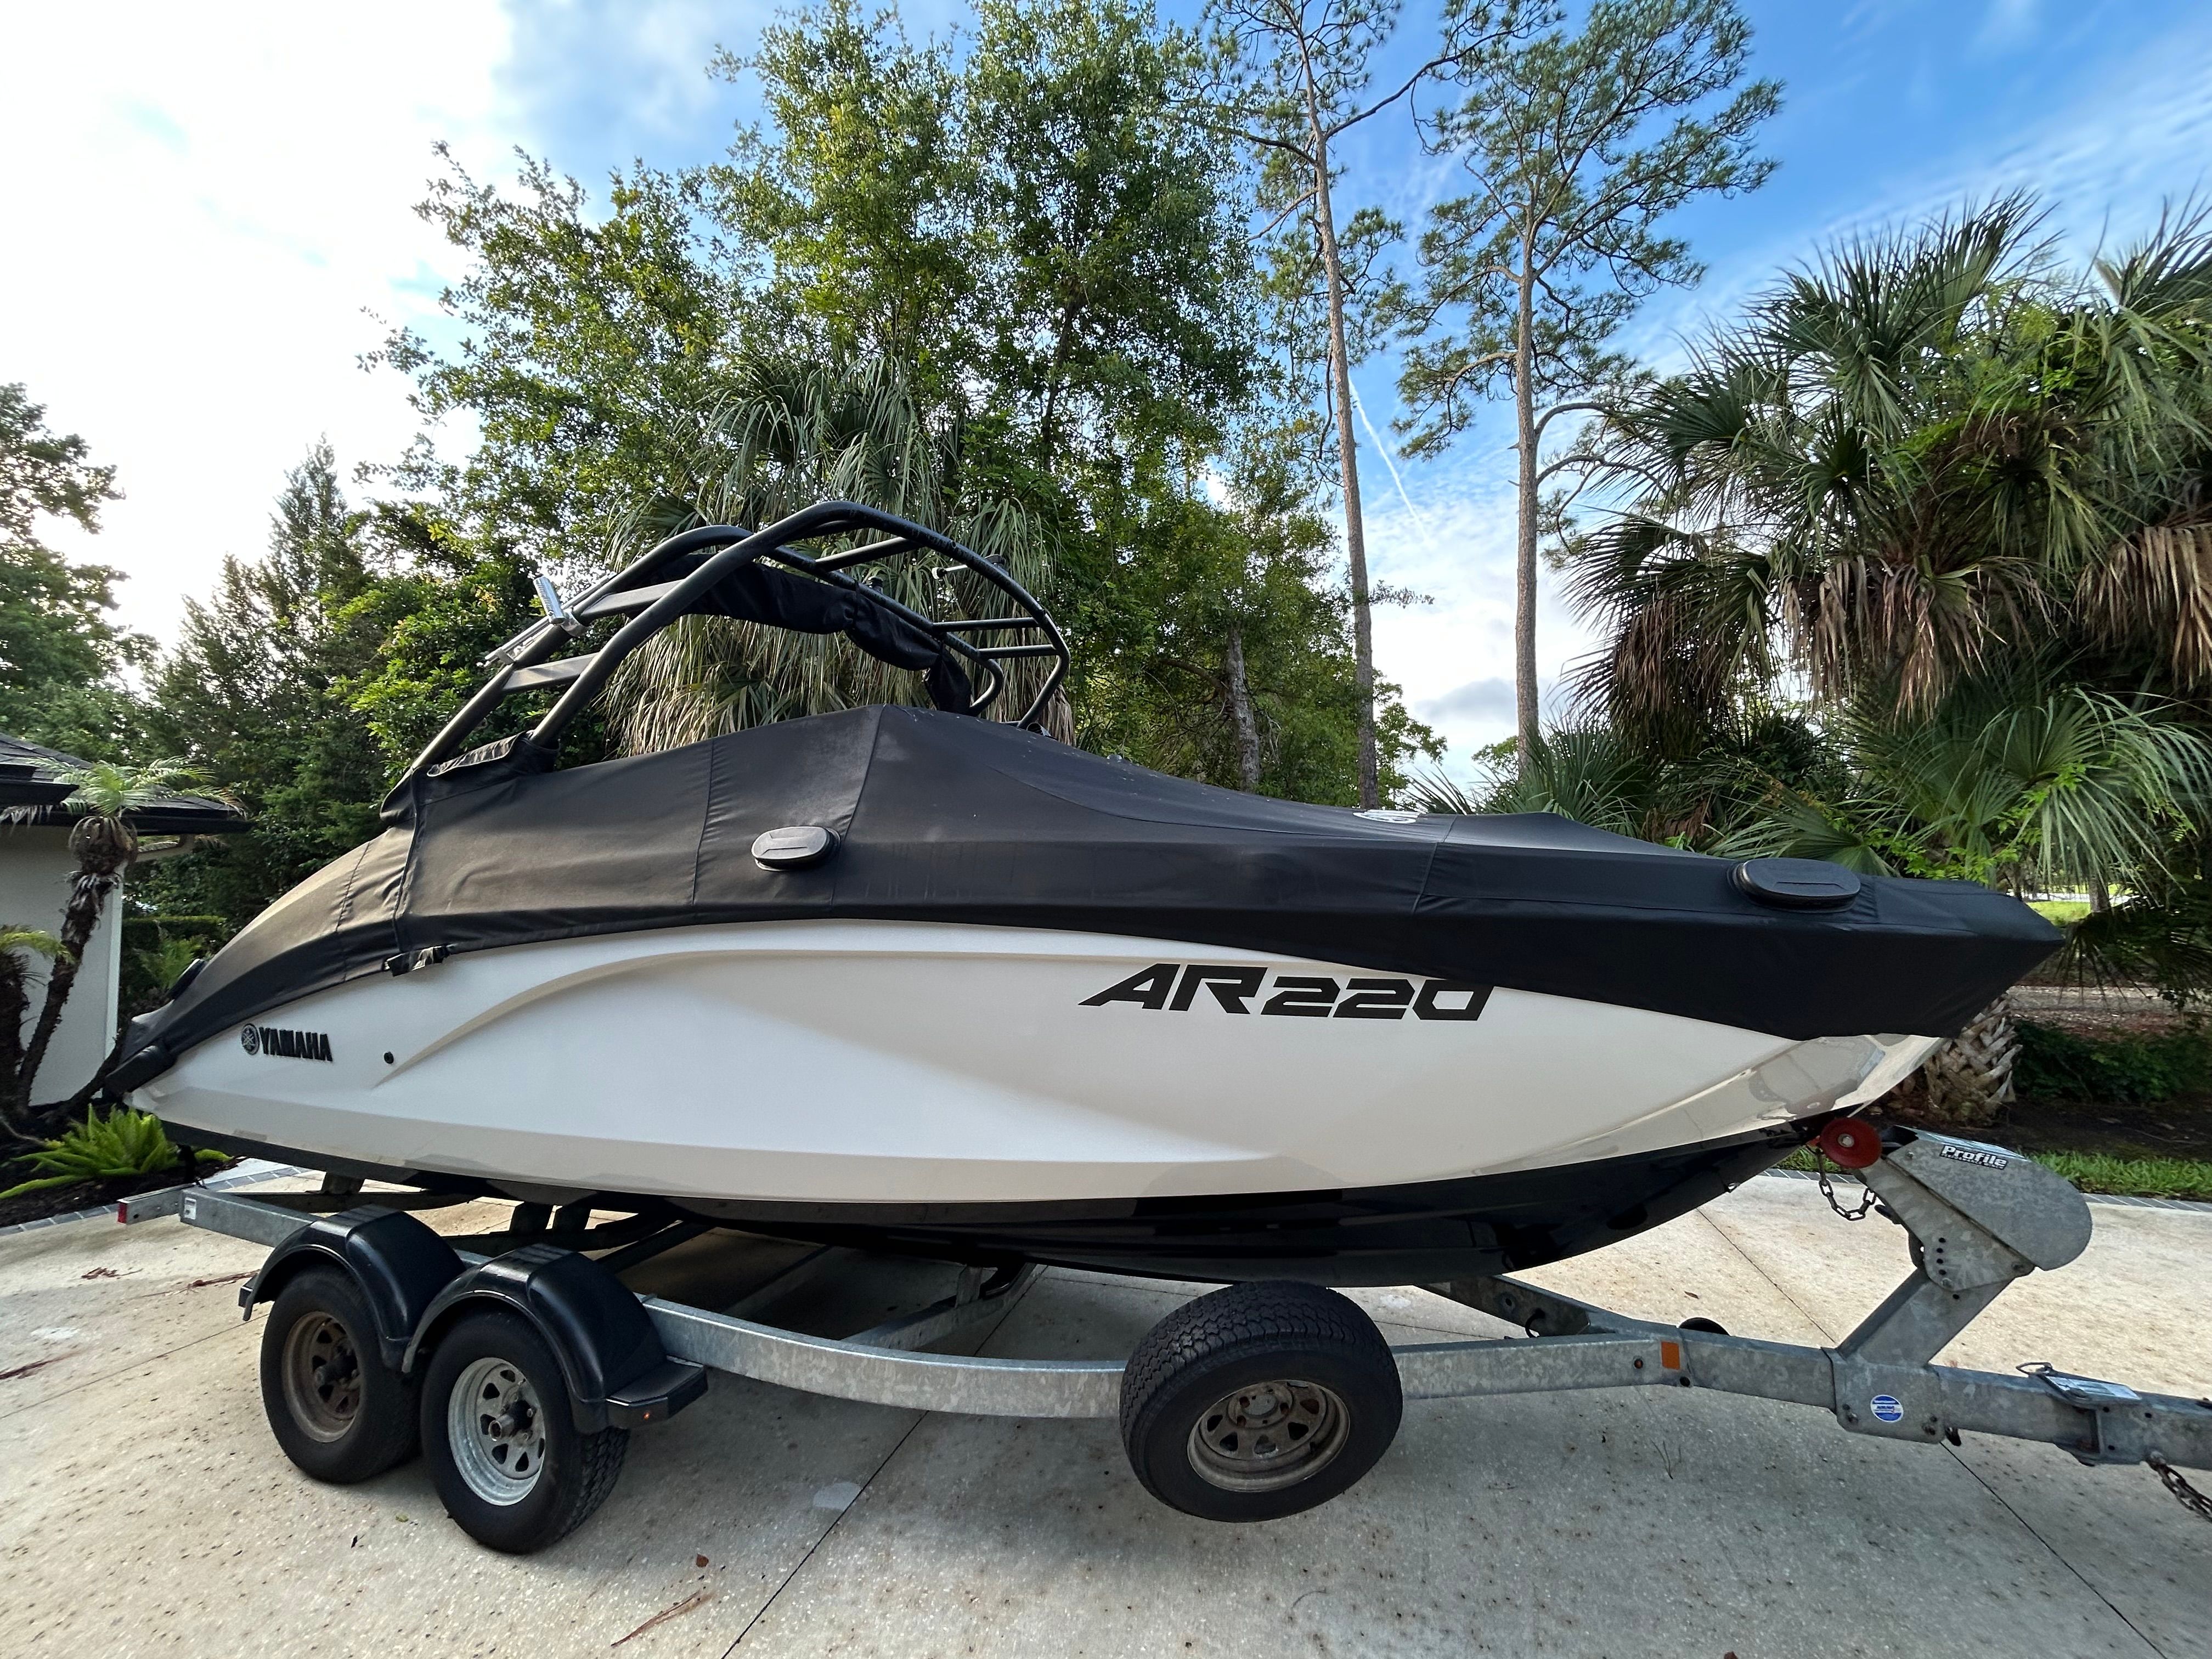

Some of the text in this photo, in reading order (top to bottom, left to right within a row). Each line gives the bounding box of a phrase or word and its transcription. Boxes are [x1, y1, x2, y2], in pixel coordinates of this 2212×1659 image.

[1078, 963, 1494, 1021] AR220
[259, 1027, 332, 1062] YAMAHA
[1942, 1145, 2007, 1167] Profile
